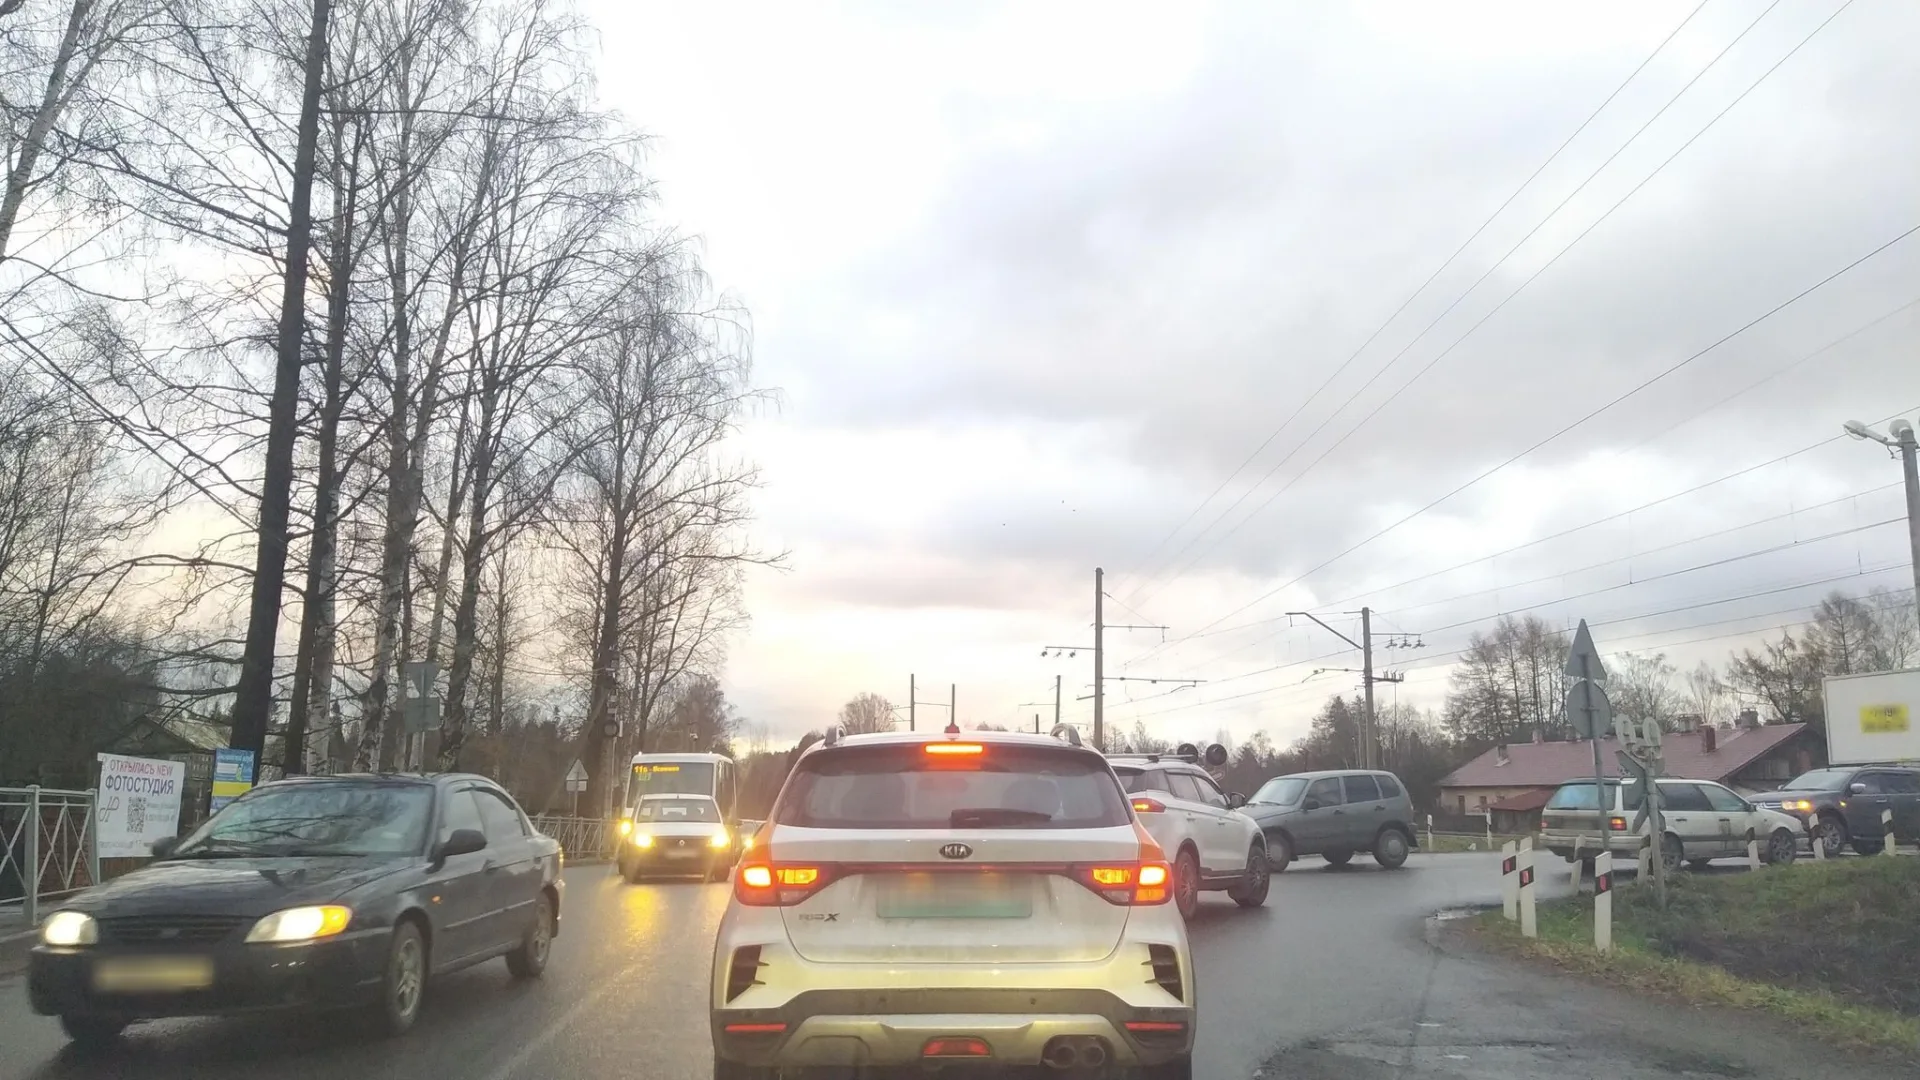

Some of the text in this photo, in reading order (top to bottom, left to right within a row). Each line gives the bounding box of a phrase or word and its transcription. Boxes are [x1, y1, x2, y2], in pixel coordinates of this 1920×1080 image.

[109, 758, 175, 777] ОТКРЫЛАСЬ NEW
[105, 774, 174, 796] ФОТОСТУДИЯ
[944, 845, 968, 856] KIA
